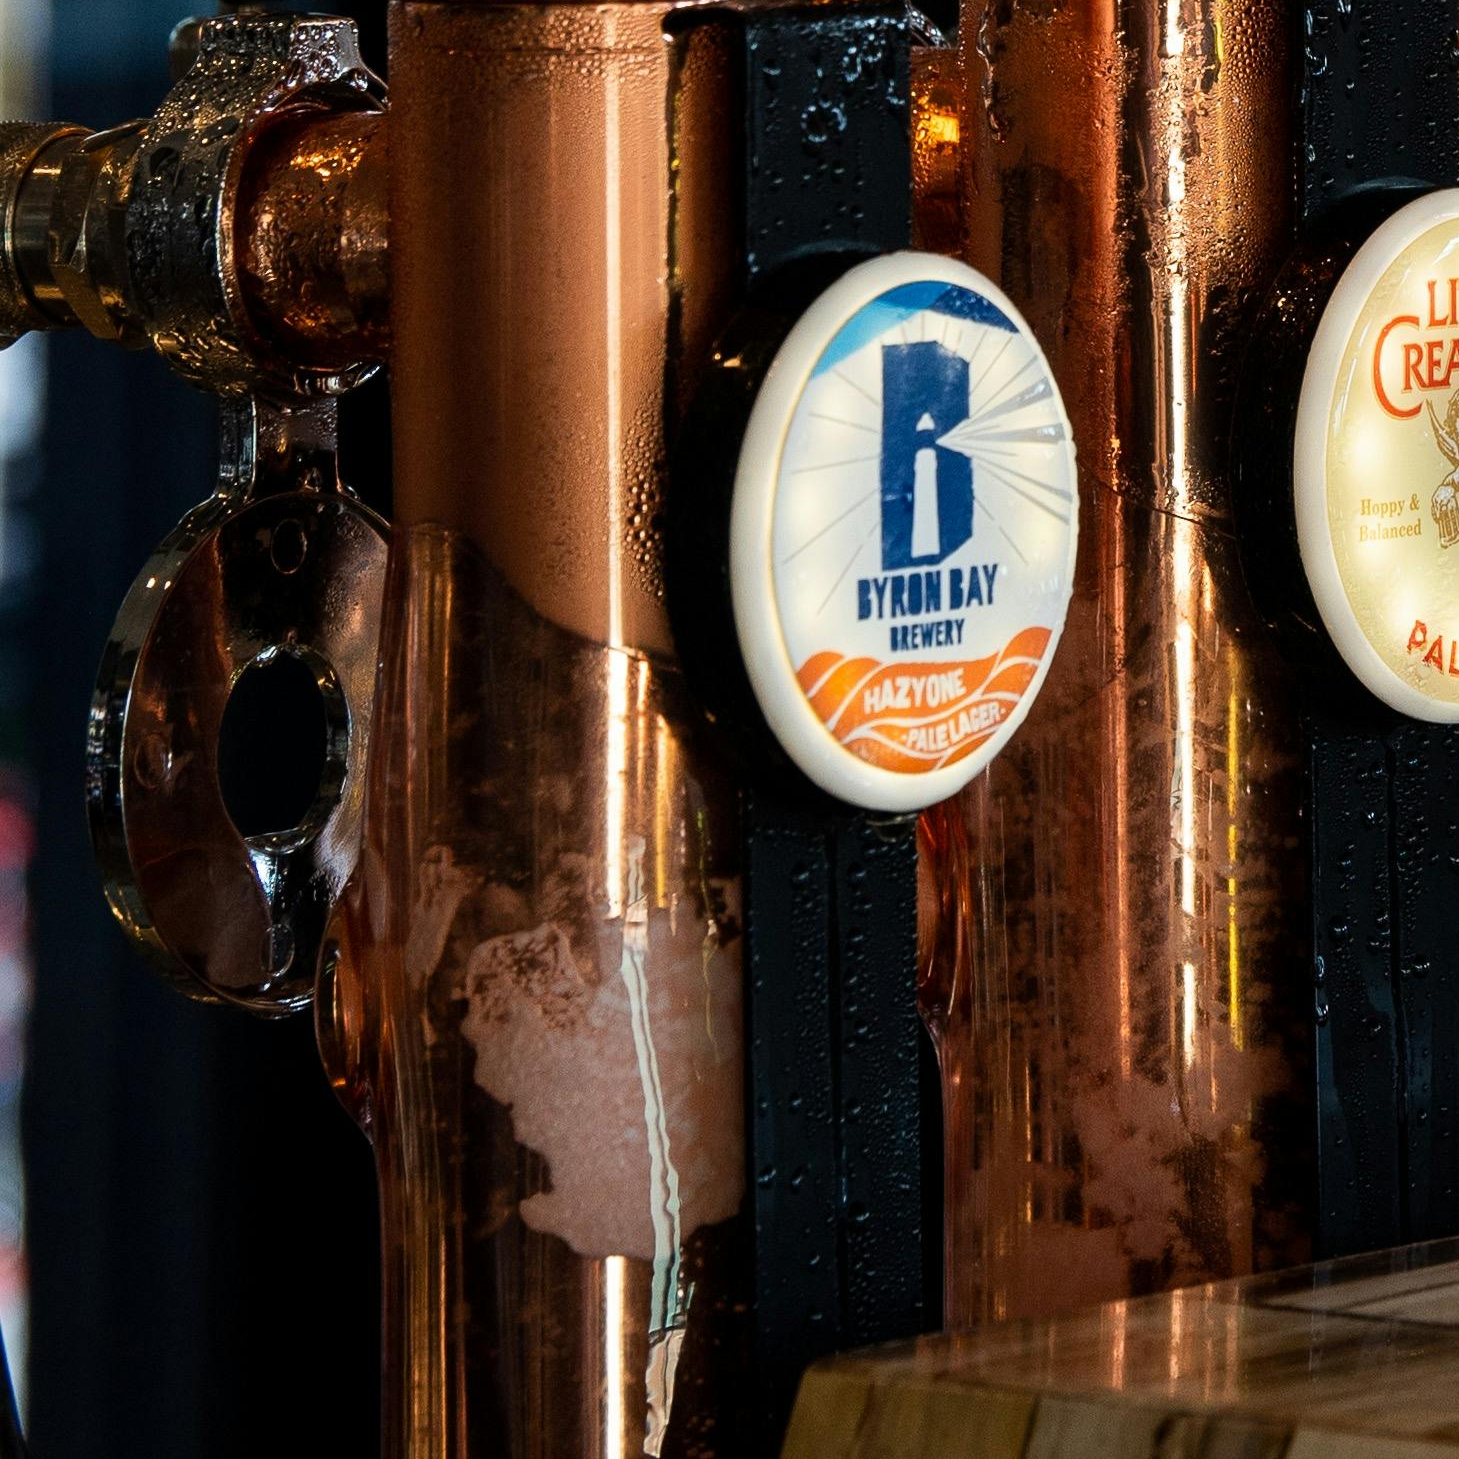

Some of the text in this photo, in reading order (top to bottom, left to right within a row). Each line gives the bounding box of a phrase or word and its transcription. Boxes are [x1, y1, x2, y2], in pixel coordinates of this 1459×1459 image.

[1360, 493, 1420, 519] Hoppy &
[1359, 518, 1422, 542] Balanced
[857, 563, 999, 621] BYRON BAY
[890, 618, 966, 652] BREWERY
